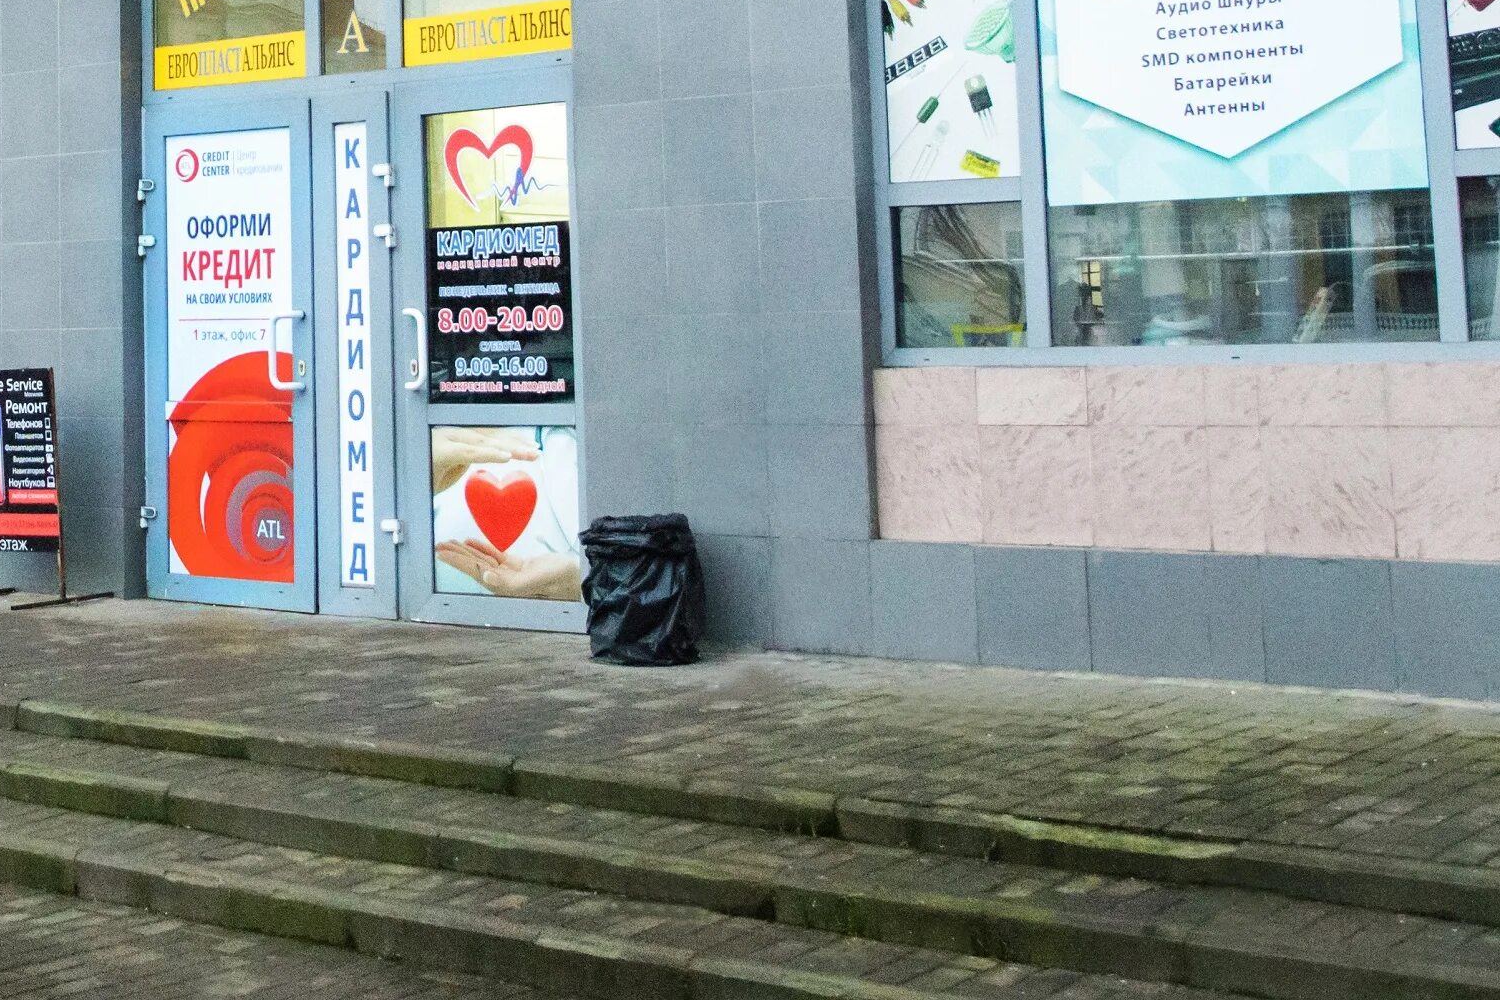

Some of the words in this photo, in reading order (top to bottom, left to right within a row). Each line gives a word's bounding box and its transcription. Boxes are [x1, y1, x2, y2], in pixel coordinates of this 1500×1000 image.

[420, 8, 571, 54] ЕВРОПЛАСТАЛЬЯНС
[1156, 19, 1285, 41] Светотехника
[167, 40, 295, 80] ЕВРОПЛАСТАЛЬЯНС
[1141, 52, 1180, 68] SMD
[1186, 44, 1304, 65] компоненты
[1174, 72, 1273, 91] Батарейки
[1184, 100, 1266, 117] Антенны
[202, 150, 230, 163] CREDIT
[202, 165, 230, 177] CENTER
[187, 213, 271, 239] ОФОРМИ
[436, 225, 560, 259] КАРДИОМЕД
[182, 248, 276, 289] КРЕДИТ
[436, 256, 518, 271] медицинский
[523, 255, 561, 269] центр
[439, 284, 508, 298] ПОНЕДЕЛЬНИК
[514, 282, 561, 296] ПЯТНИЦА
[186, 294, 197, 305] НА
[199, 293, 227, 305] СВОИХ
[229, 292, 273, 304] УСЛОВИЯХ
[438, 304, 564, 333] 8.00-20.00
[193, 329, 199, 341] 1
[201, 330, 228, 342] этаж,
[230, 329, 257, 342] офис
[259, 328, 266, 340] 7
[479, 340, 522, 352] СУББОТА
[343, 137, 370, 582] КАРДИОМЕД
[455, 356, 548, 377] 9.00-16.00
[6, 377, 44, 392] Service
[439, 381, 503, 393] ВОСКРЕСЕНЬЕ
[510, 379, 566, 394] ВЫХОДНОЙ
[5, 400, 48, 414] Ремонт
[5, 418, 44, 431] Телефонов
[8, 477, 46, 489] Ноутбуков
[256, 519, 286, 539] ATL
[0, 537, 29, 551] этаж
